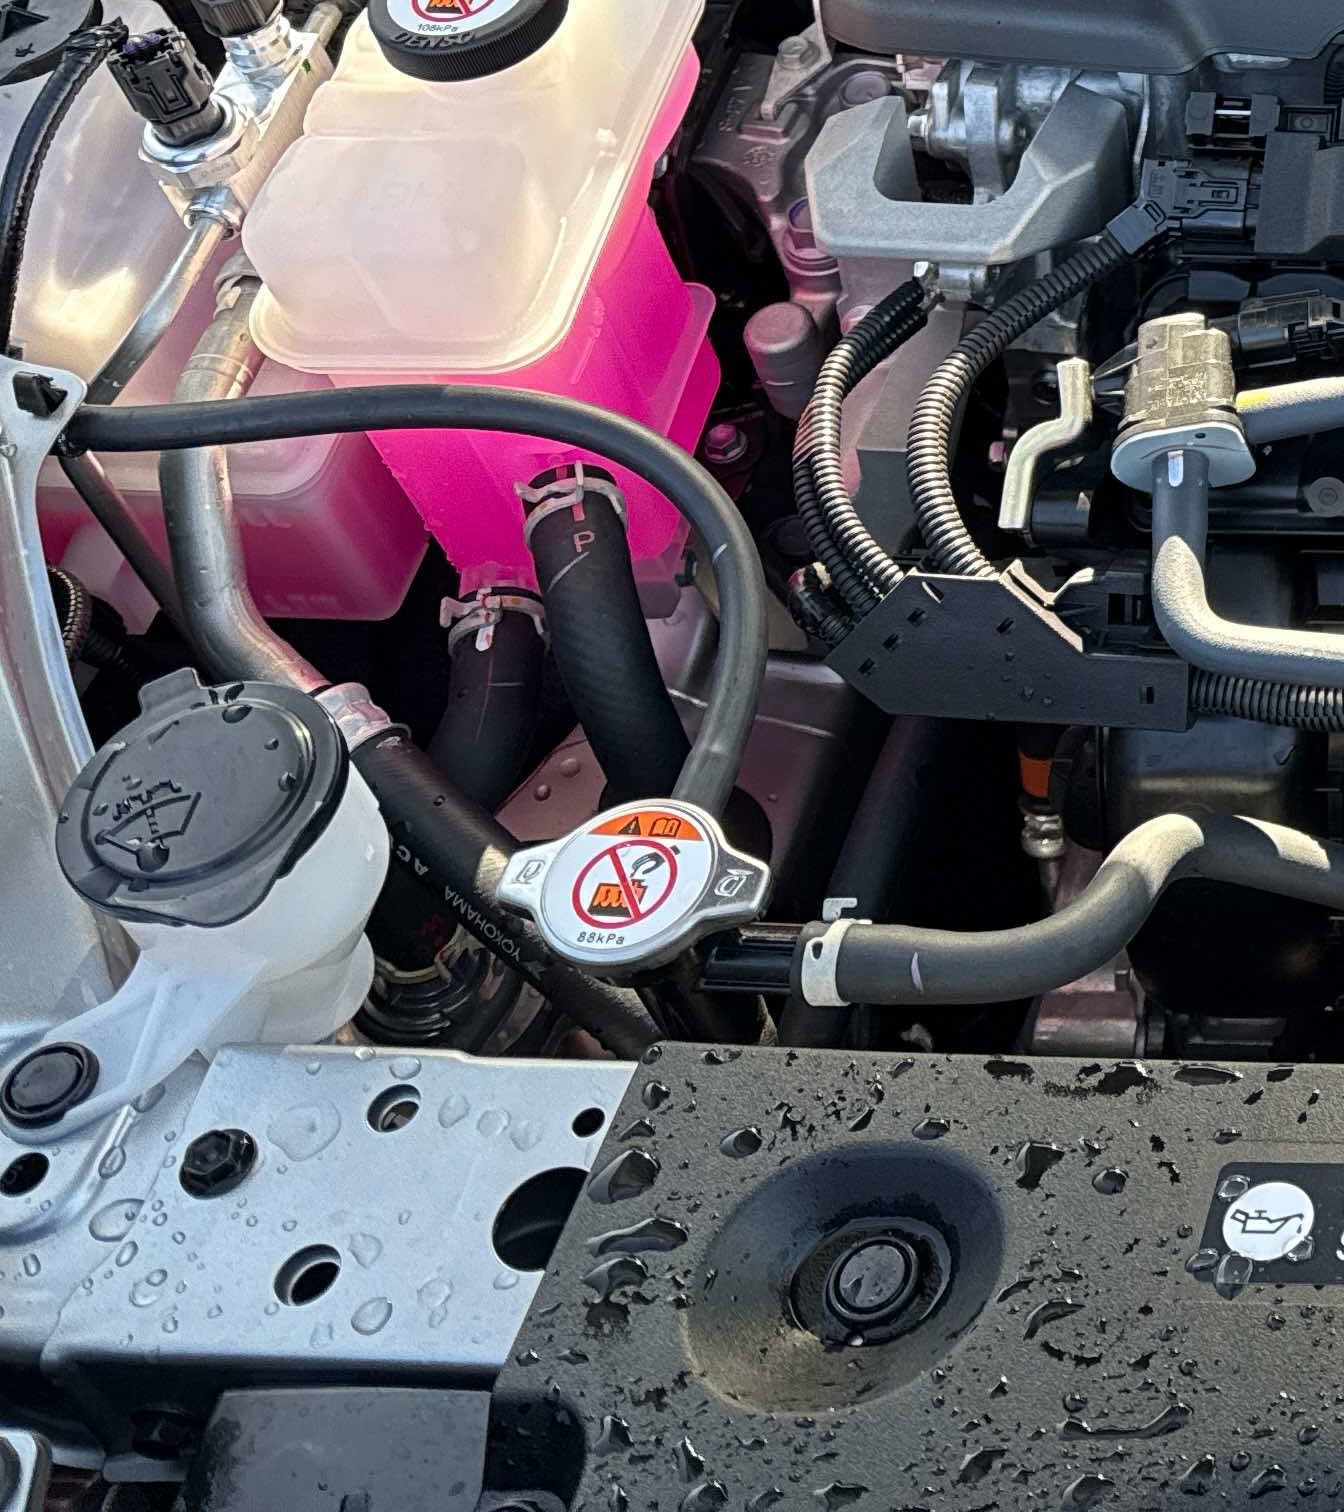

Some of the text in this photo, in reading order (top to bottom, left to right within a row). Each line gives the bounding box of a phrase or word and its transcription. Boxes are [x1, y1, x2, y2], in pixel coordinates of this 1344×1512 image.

[392, 31, 476, 49] DENSO
[574, 530, 595, 552] P
[444, 885, 521, 963] YOKOHAMA
[576, 930, 625, 946] 88kPa
